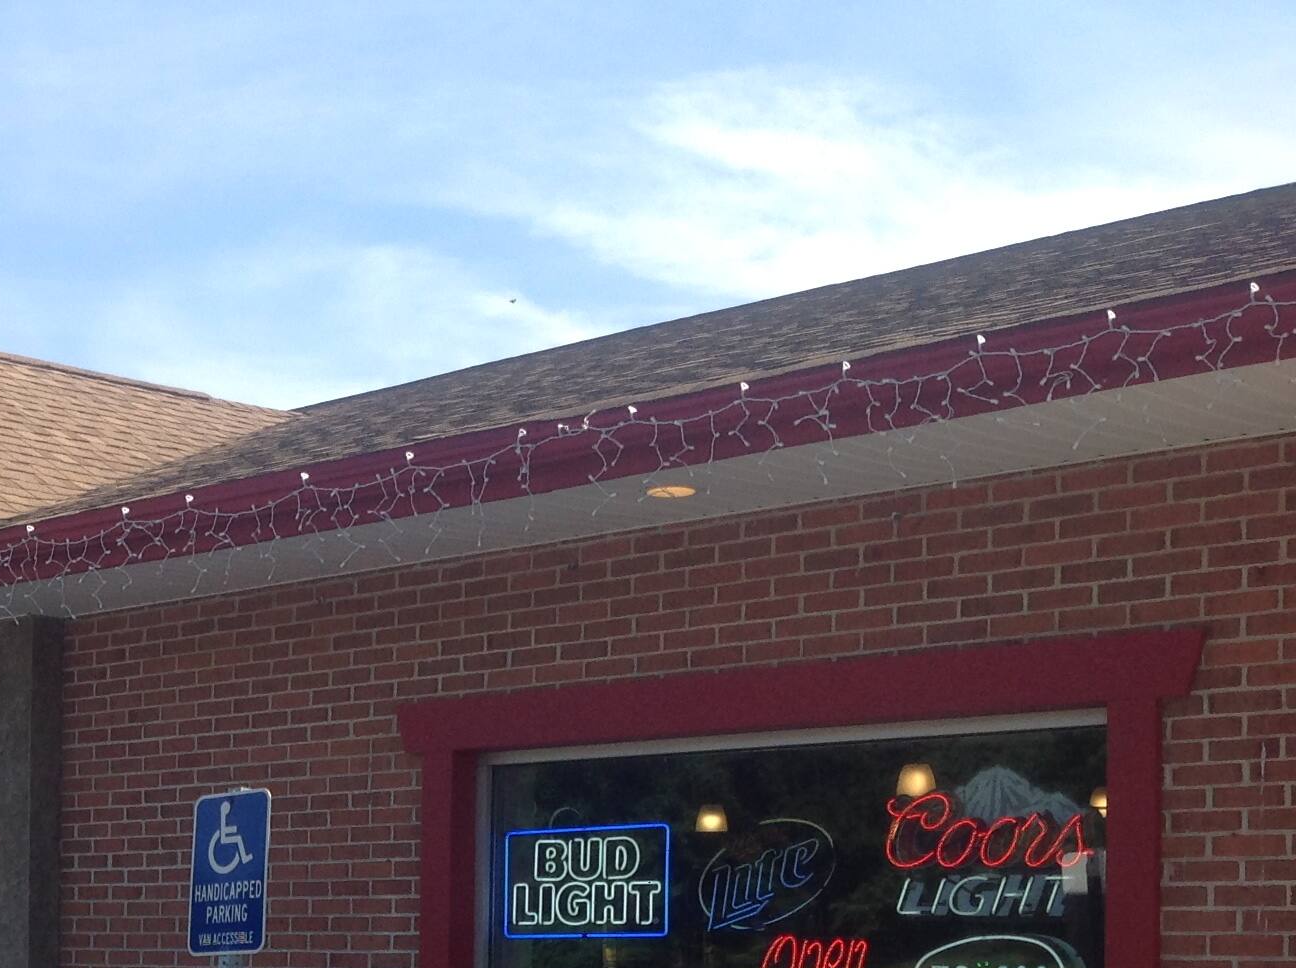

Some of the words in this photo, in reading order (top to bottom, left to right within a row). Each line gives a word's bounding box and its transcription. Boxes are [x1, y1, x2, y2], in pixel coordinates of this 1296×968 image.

[885, 793, 1096, 869] Coors
[533, 835, 641, 882] BUD
[194, 879, 262, 903] HANDICAPPED
[205, 903, 248, 924] PARKING
[511, 880, 662, 926] LIGHT
[896, 873, 1074, 918] LIGHT
[198, 932, 212, 946] VAN
[212, 930, 255, 946] ACCESSIBLE
